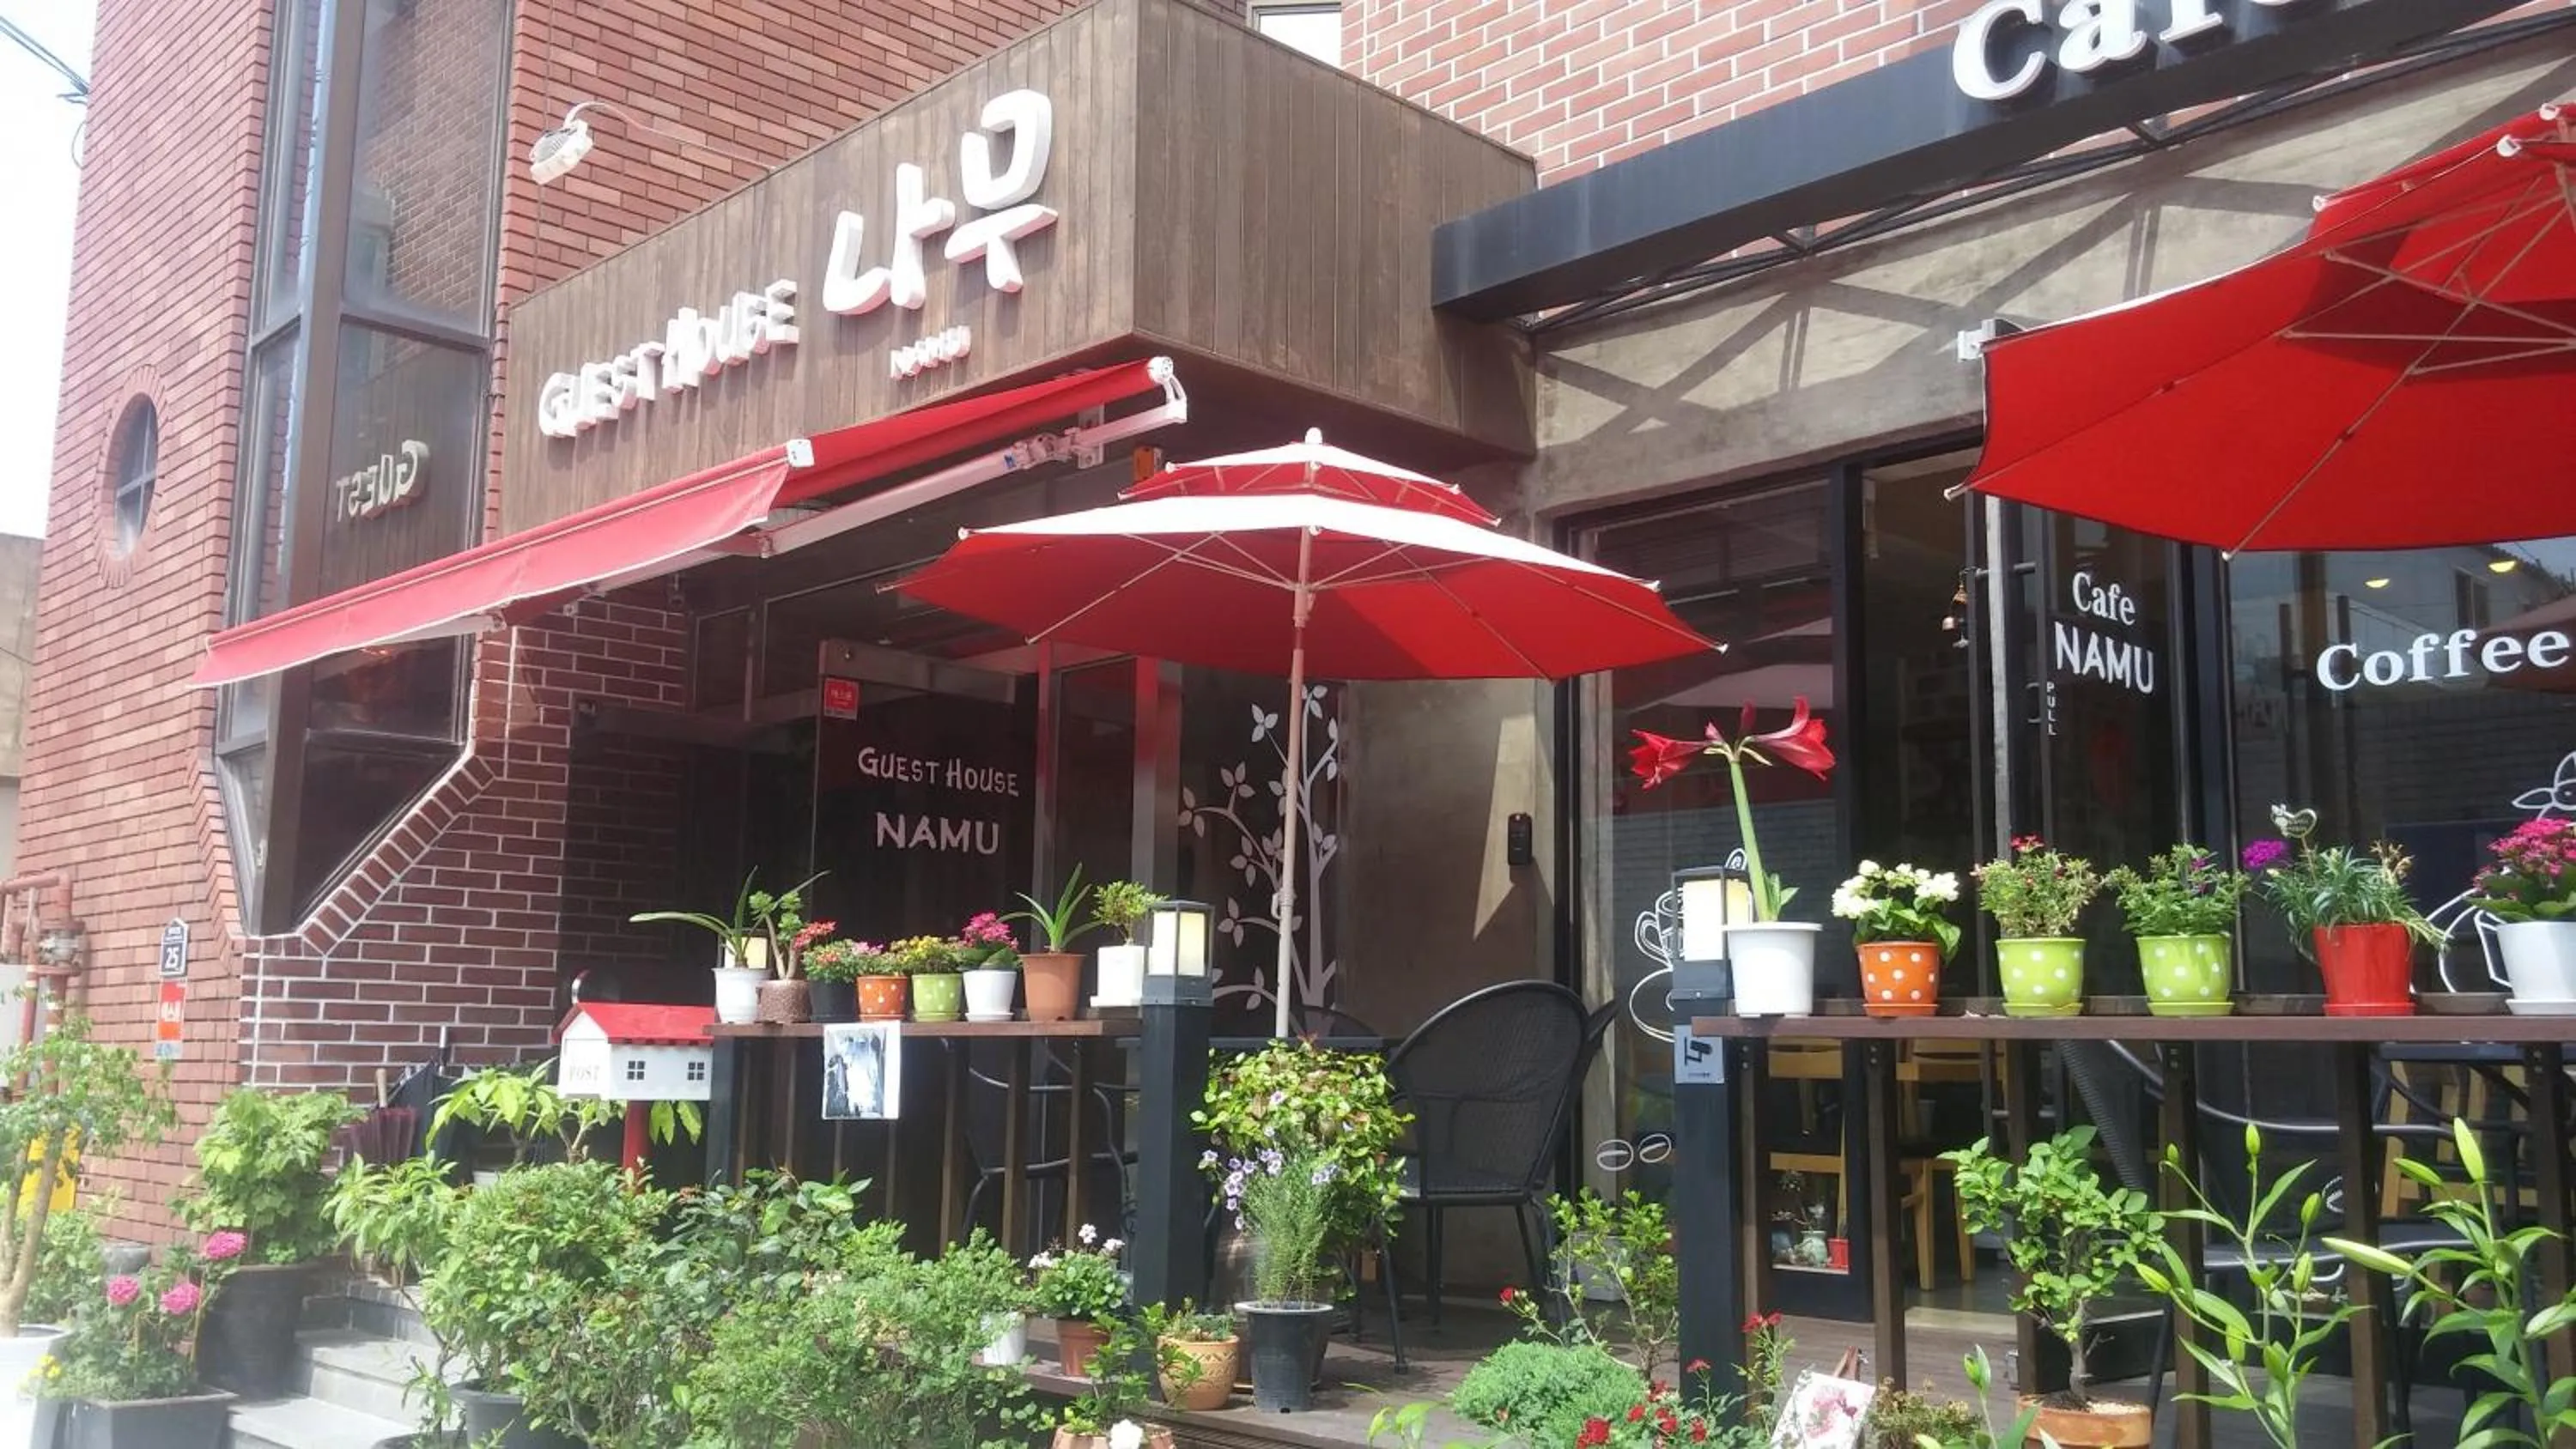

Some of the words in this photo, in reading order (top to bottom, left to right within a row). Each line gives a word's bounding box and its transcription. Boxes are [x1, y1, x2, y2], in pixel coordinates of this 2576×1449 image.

[823, 89, 1059, 315] 나무
[538, 342, 665, 438] GUEST
[662, 279, 799, 395] HOUSE
[2073, 572, 2136, 626] Cafe
[2055, 621, 2154, 694] NAMU
[2317, 629, 2570, 691] Coffee
[2046, 682, 2057, 736] PULL
[858, 746, 940, 785] GUEST
[946, 758, 1019, 797] HOUSE
[875, 811, 999, 854] NAMU
[164, 947, 179, 969] 25
